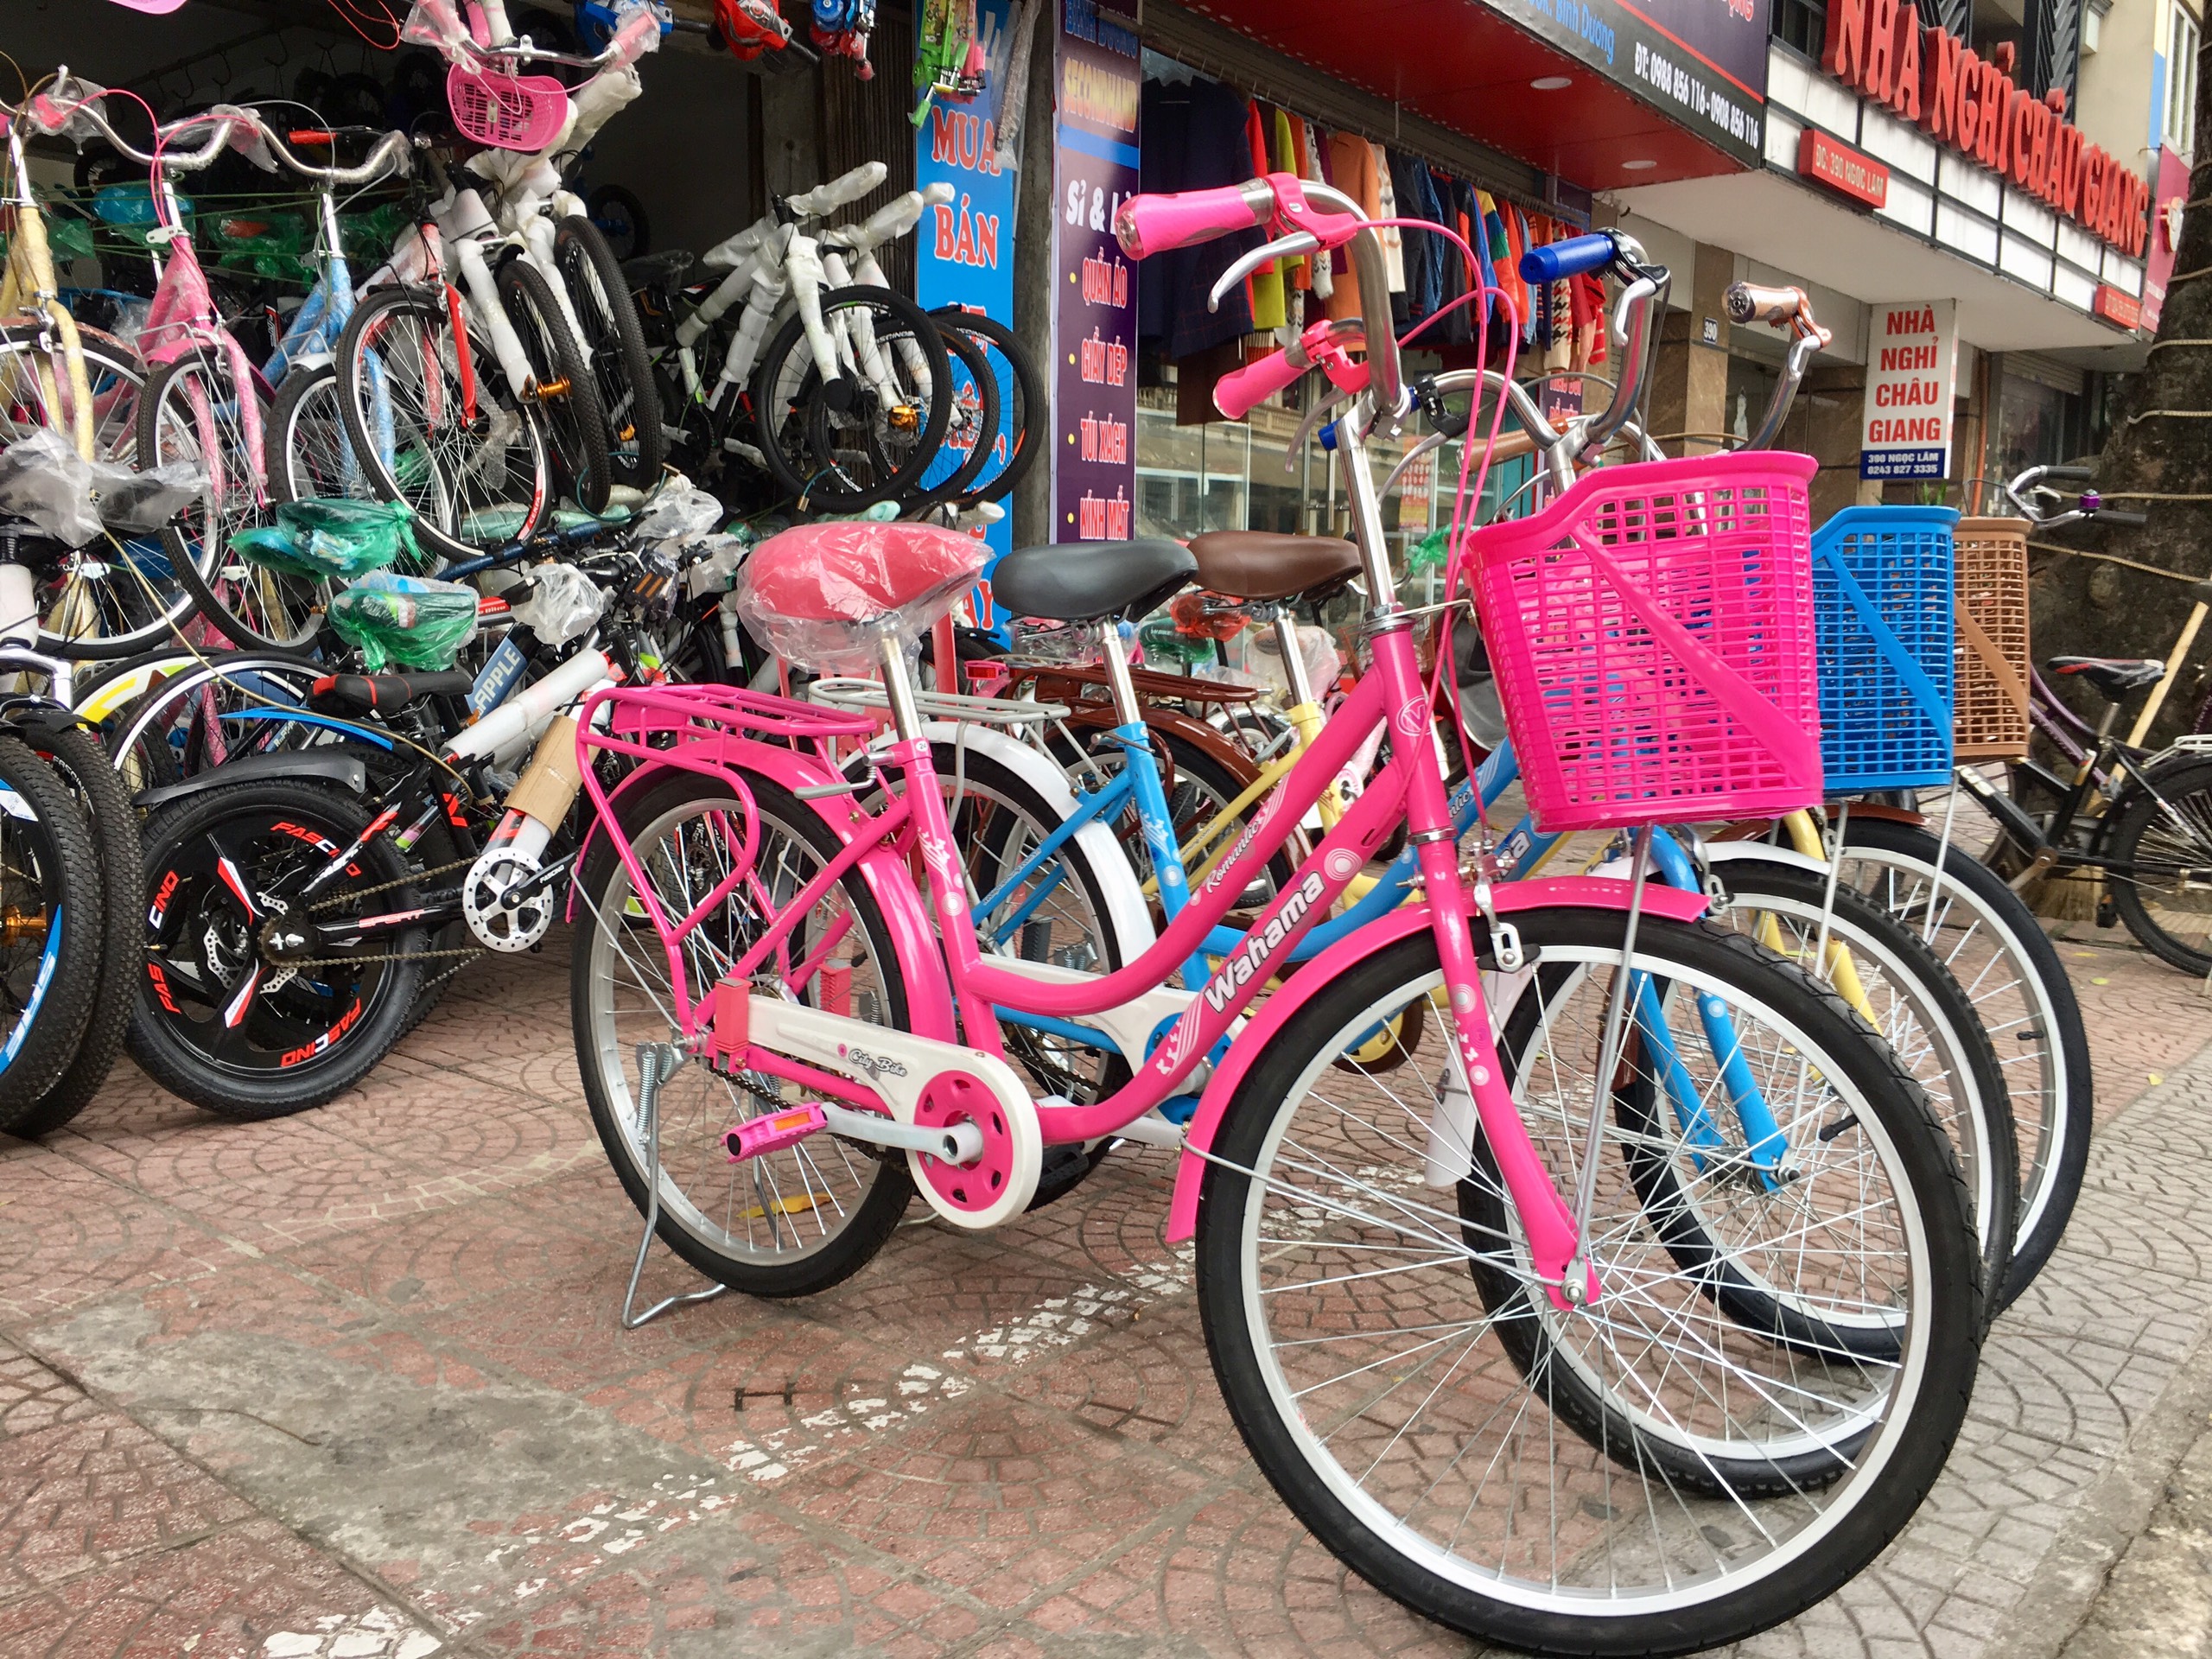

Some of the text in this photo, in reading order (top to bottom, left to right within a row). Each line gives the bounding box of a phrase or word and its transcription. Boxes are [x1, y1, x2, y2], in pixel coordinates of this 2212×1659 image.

[1650, 52, 1672, 95] 0988
[1673, 67, 1689, 105] 856
[1691, 78, 1706, 116] 116
[1711, 92, 1730, 131] 0908
[1730, 105, 1745, 140] 856
[1745, 114, 1759, 149] 116
[931, 105, 1001, 176] MUA
[1931, 26, 2014, 173] NGHỈ
[2012, 88, 2084, 214] CHÂU
[2082, 143, 2149, 257] GIANG
[933, 193, 999, 270] BÁN
[1090, 187, 1106, 233] &
[1112, 255, 1128, 309] ÁO
[1886, 303, 1935, 335] NHÀ
[1107, 334, 1128, 387] DÉP
[1880, 335, 1939, 372] NGHỈ
[1875, 377, 1939, 407] CHÂU
[1080, 410, 1127, 465] TÚI XÁCH
[1868, 417, 1941, 442] GIANG
[1867, 465, 1891, 475] 0243
[1913, 464, 1938, 474] 3335
[1917, 451, 1939, 462] LÂM
[1080, 489, 1106, 540] KÍNH
[270, 821, 362, 878] FASCIO
[1204, 870, 1326, 1014] Wahama
[848, 1048, 908, 1077] City Bike
